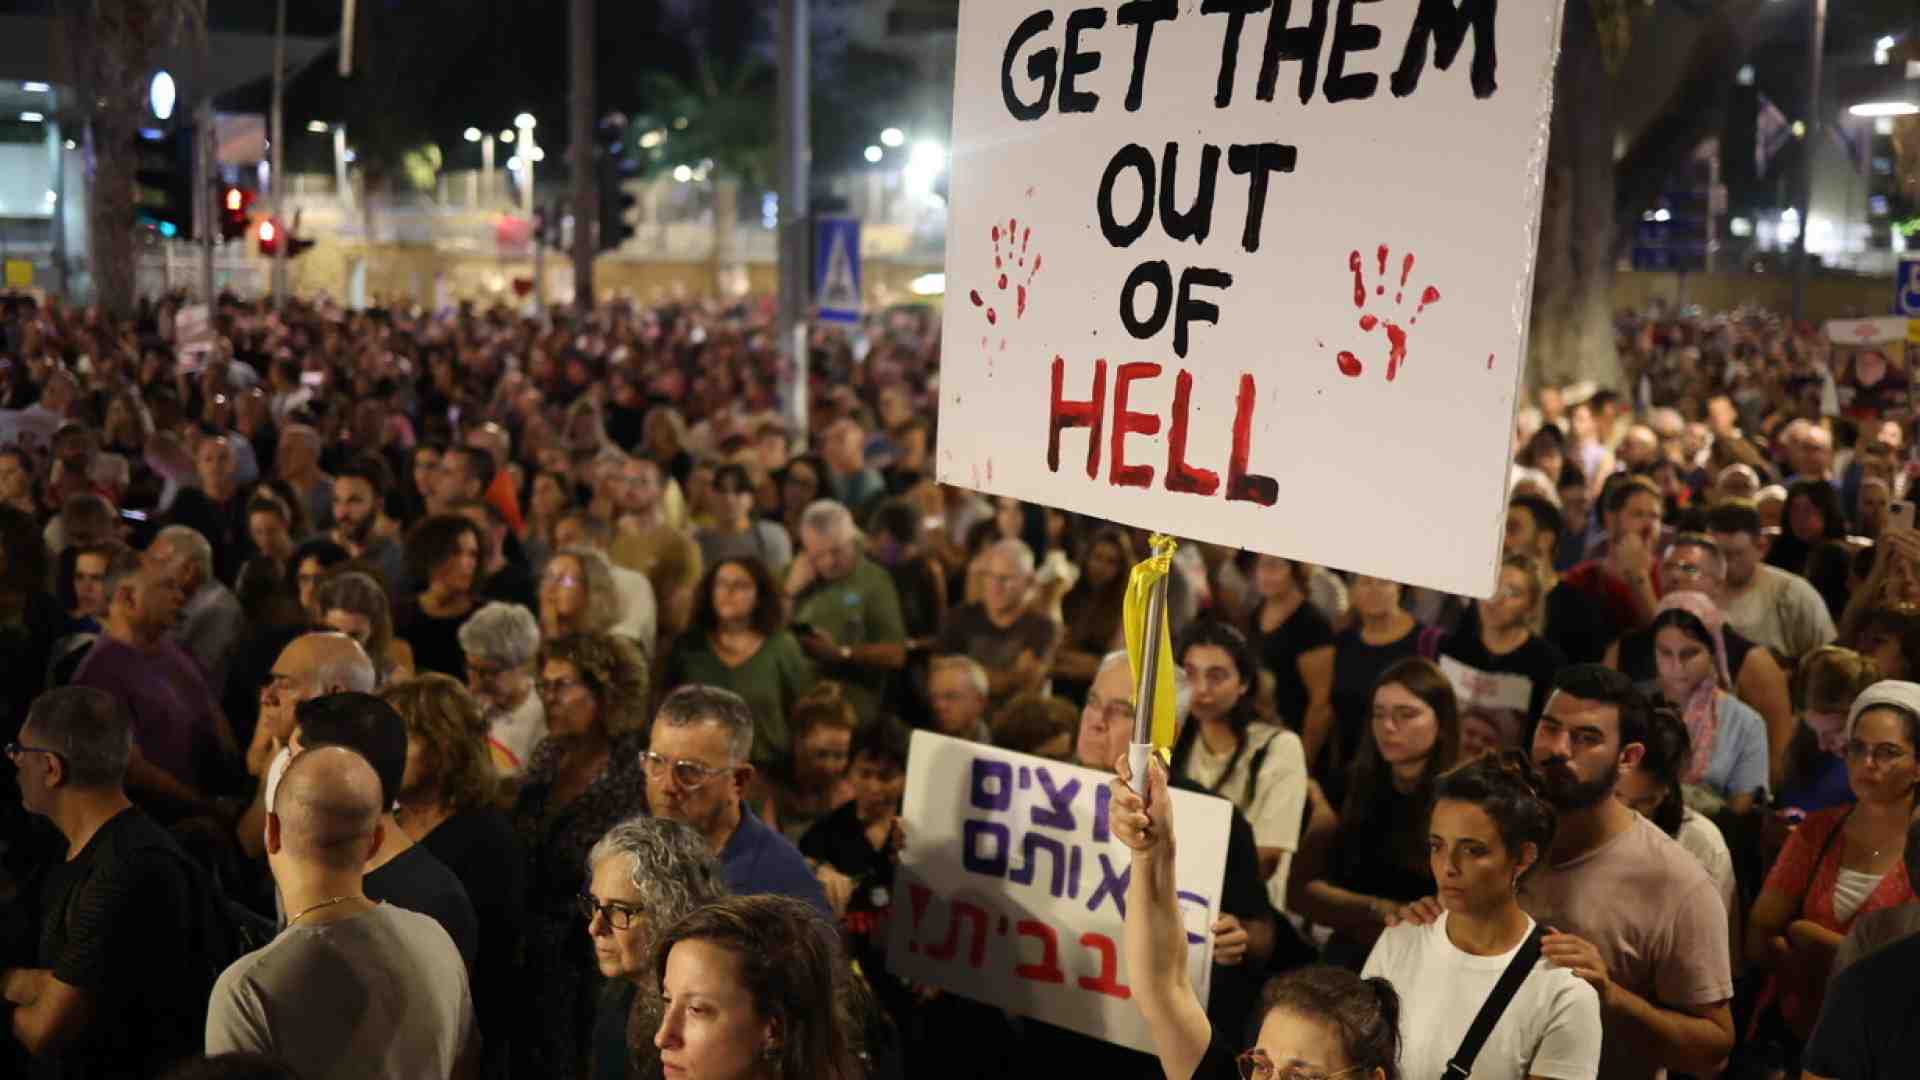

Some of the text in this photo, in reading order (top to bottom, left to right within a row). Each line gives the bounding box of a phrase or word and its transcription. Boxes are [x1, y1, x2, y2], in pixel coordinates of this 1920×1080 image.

[1002, 0, 1497, 120] GET THEM
[1097, 142, 1297, 253] OUT
[1120, 260, 1232, 358] OF
[1046, 355, 1279, 507] HELL
[971, 758, 1112, 842] וצים
[963, 819, 1131, 922] אותם
[908, 883, 1132, 1000] בבית!
